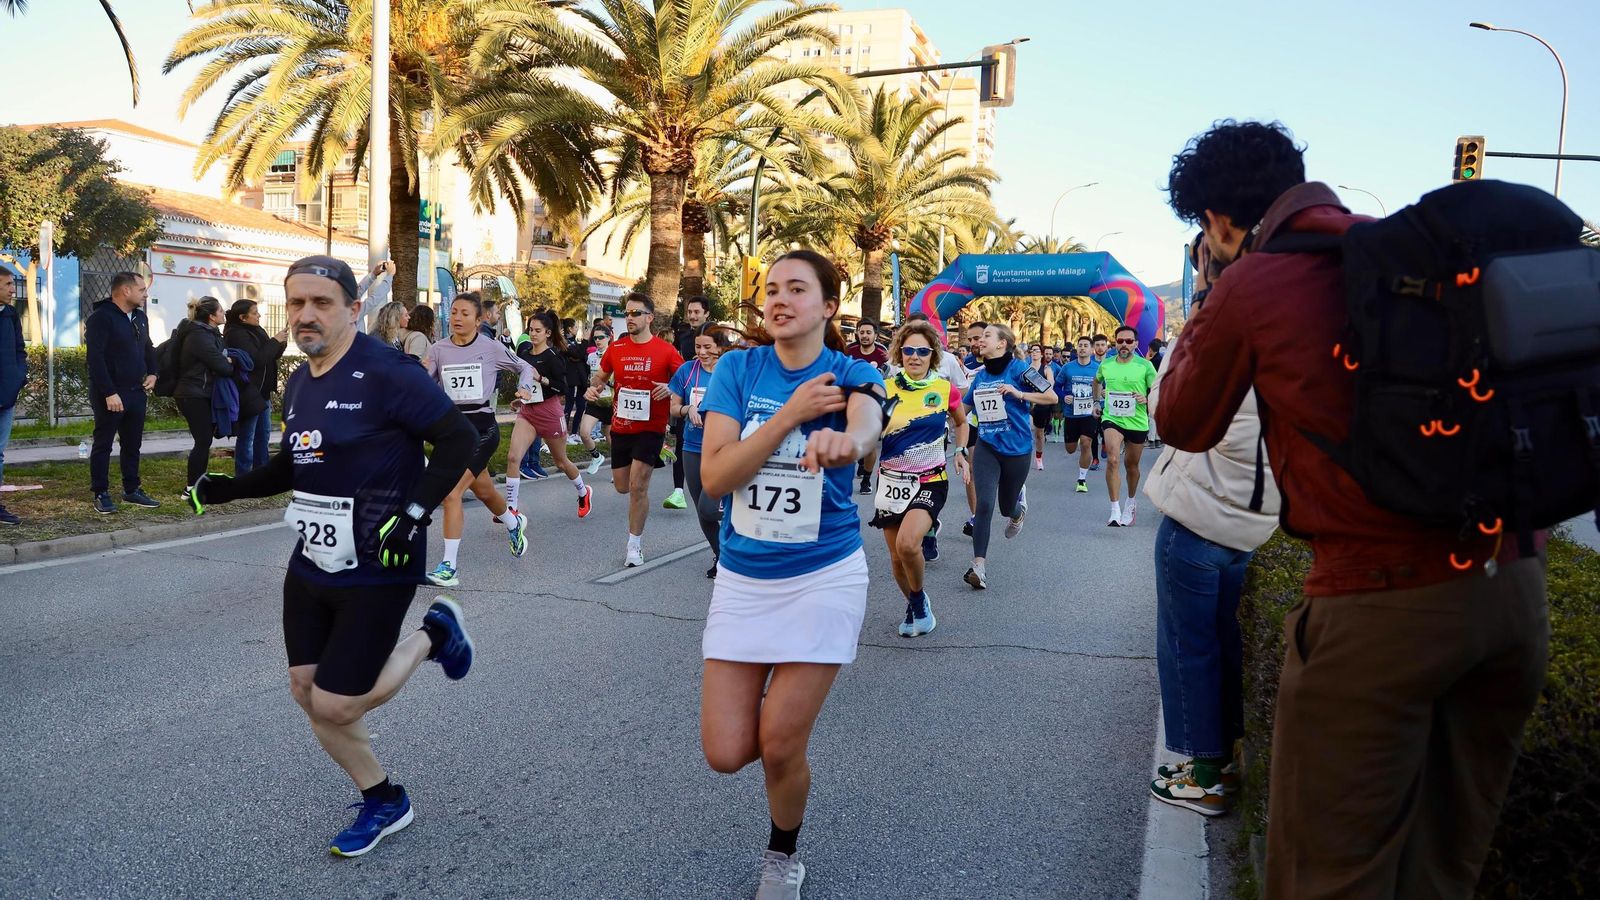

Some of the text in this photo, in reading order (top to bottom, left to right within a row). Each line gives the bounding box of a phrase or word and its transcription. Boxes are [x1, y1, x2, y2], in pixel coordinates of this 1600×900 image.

[992, 268, 1044, 278] Ayuntamiento
[1058, 267, 1086, 276] Málaga
[450, 376, 474, 388] 371
[339, 402, 362, 411] mupol
[624, 399, 643, 410] 191
[758, 397, 784, 406] CARRERA
[981, 400, 998, 411] 172
[1112, 400, 1130, 409] 423
[289, 430, 322, 451] 200
[885, 484, 910, 500] 208
[748, 484, 801, 514] 173
[296, 520, 337, 548] 328
